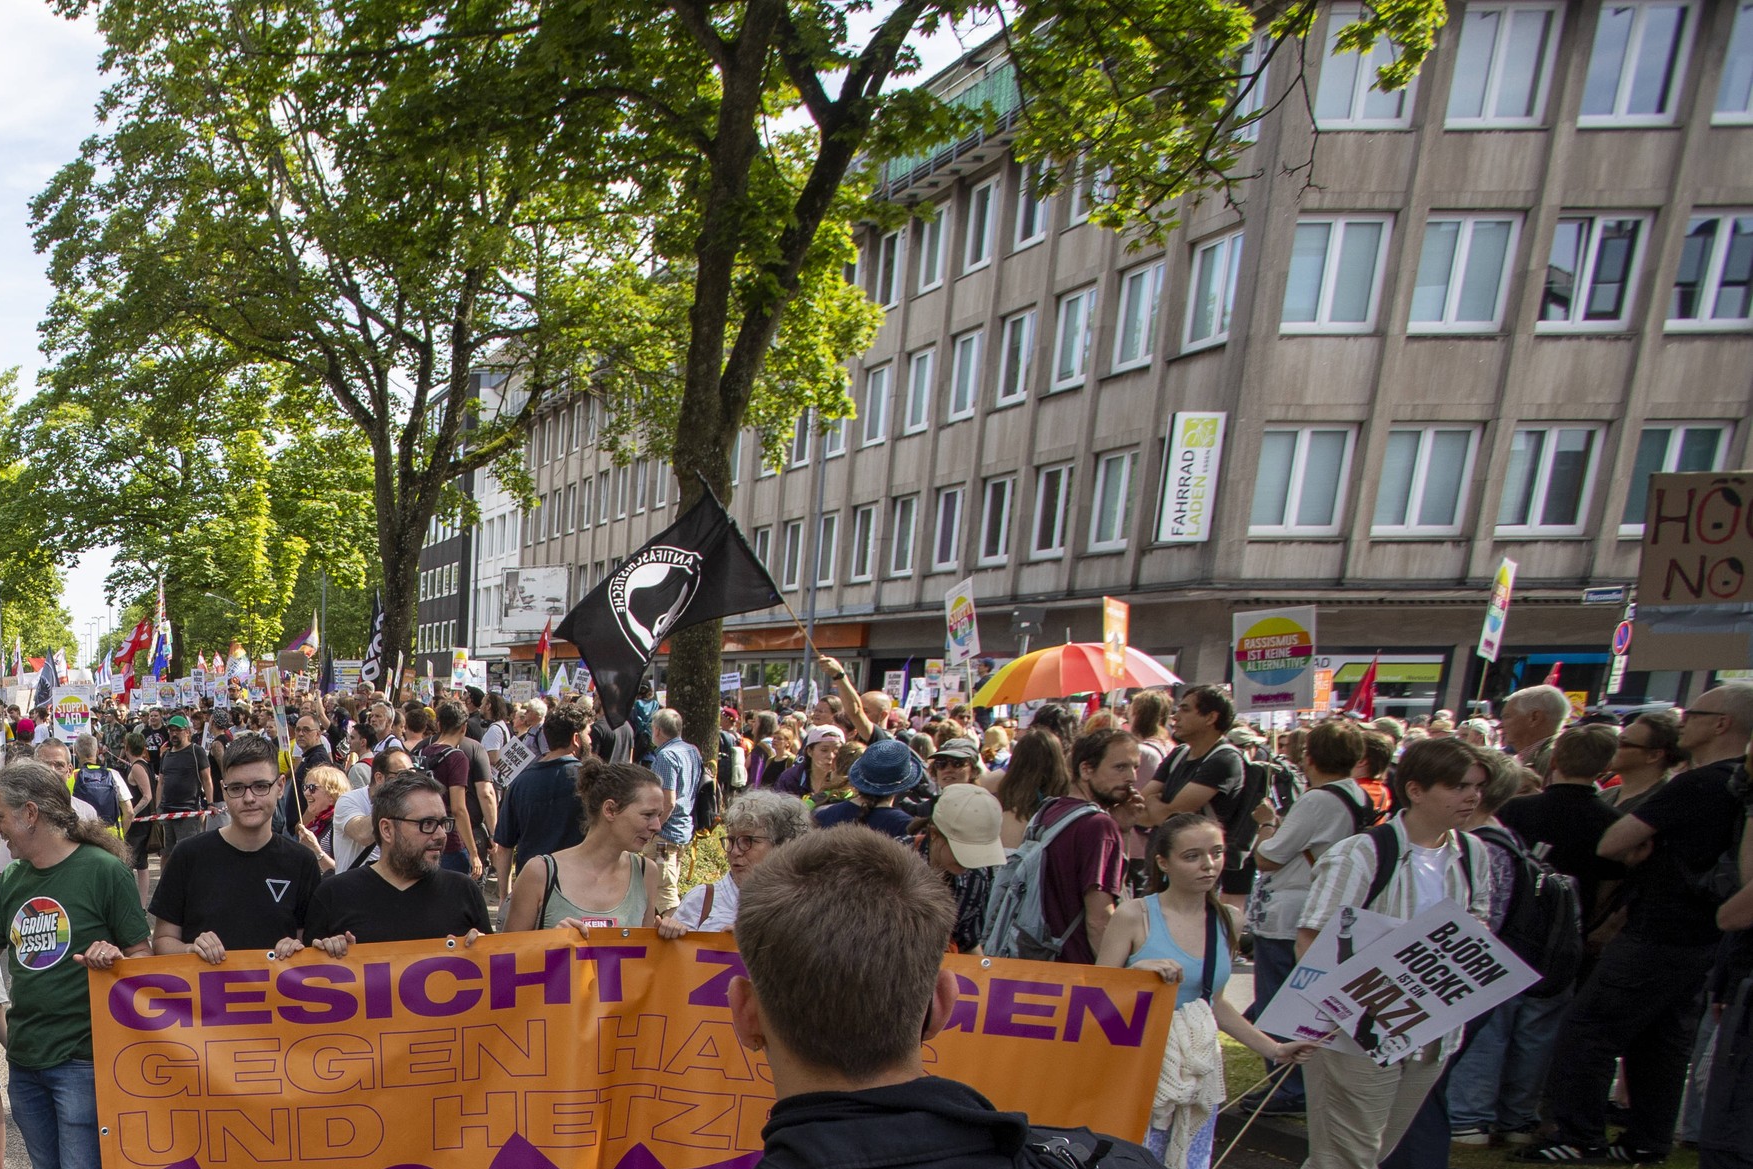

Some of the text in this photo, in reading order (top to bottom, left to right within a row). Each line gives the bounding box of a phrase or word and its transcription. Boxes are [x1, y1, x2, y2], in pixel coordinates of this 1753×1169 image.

[1171, 450, 1195, 536] FAHRRAD
[1186, 476, 1208, 536] LADEN
[1650, 477, 1753, 545] HÖ
[1244, 634, 1299, 649] RASSISMUS
[1247, 646, 1292, 660] IST KEINE
[1246, 656, 1307, 672] ALTERNATIVE
[57, 702, 87, 714] STOPPT
[65, 712, 82, 726] AFD
[504, 749, 523, 767] HÖCKE
[511, 742, 529, 760] BJÖRN
[493, 758, 514, 779] NAZI
[21, 912, 59, 936] GRÜNE
[20, 932, 57, 954] ESSEN
[1426, 920, 1509, 987] BJÖRN
[1393, 940, 1474, 1007] HÖCKE
[1396, 972, 1428, 999] IST EIN
[107, 945, 646, 1030] GESICHT
[1340, 966, 1431, 1038] NAZI
[113, 1018, 546, 1099] GEGEN
[118, 1104, 384, 1167] UND
